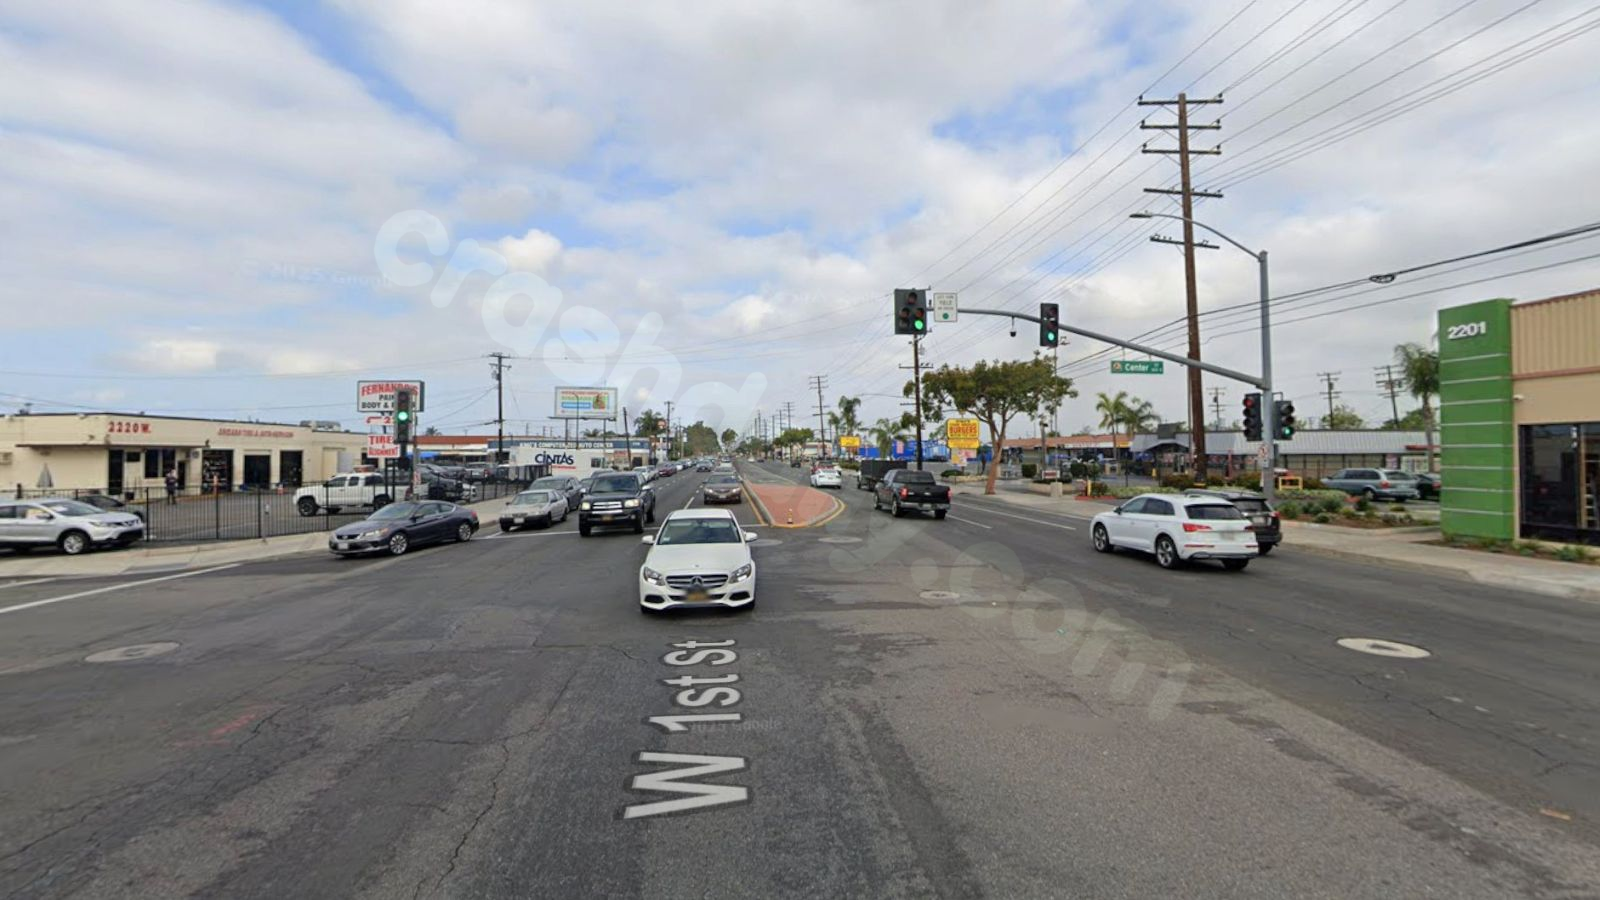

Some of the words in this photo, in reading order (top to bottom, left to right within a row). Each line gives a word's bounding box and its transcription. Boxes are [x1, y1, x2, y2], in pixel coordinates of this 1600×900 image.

[1448, 321, 1486, 339] 2201
[1125, 363, 1149, 371] Center
[361, 401, 381, 409] BODY
[383, 401, 390, 409] &
[108, 421, 139, 433] 2220
[949, 425, 977, 434] BURGERS
[368, 435, 394, 445] TIRE
